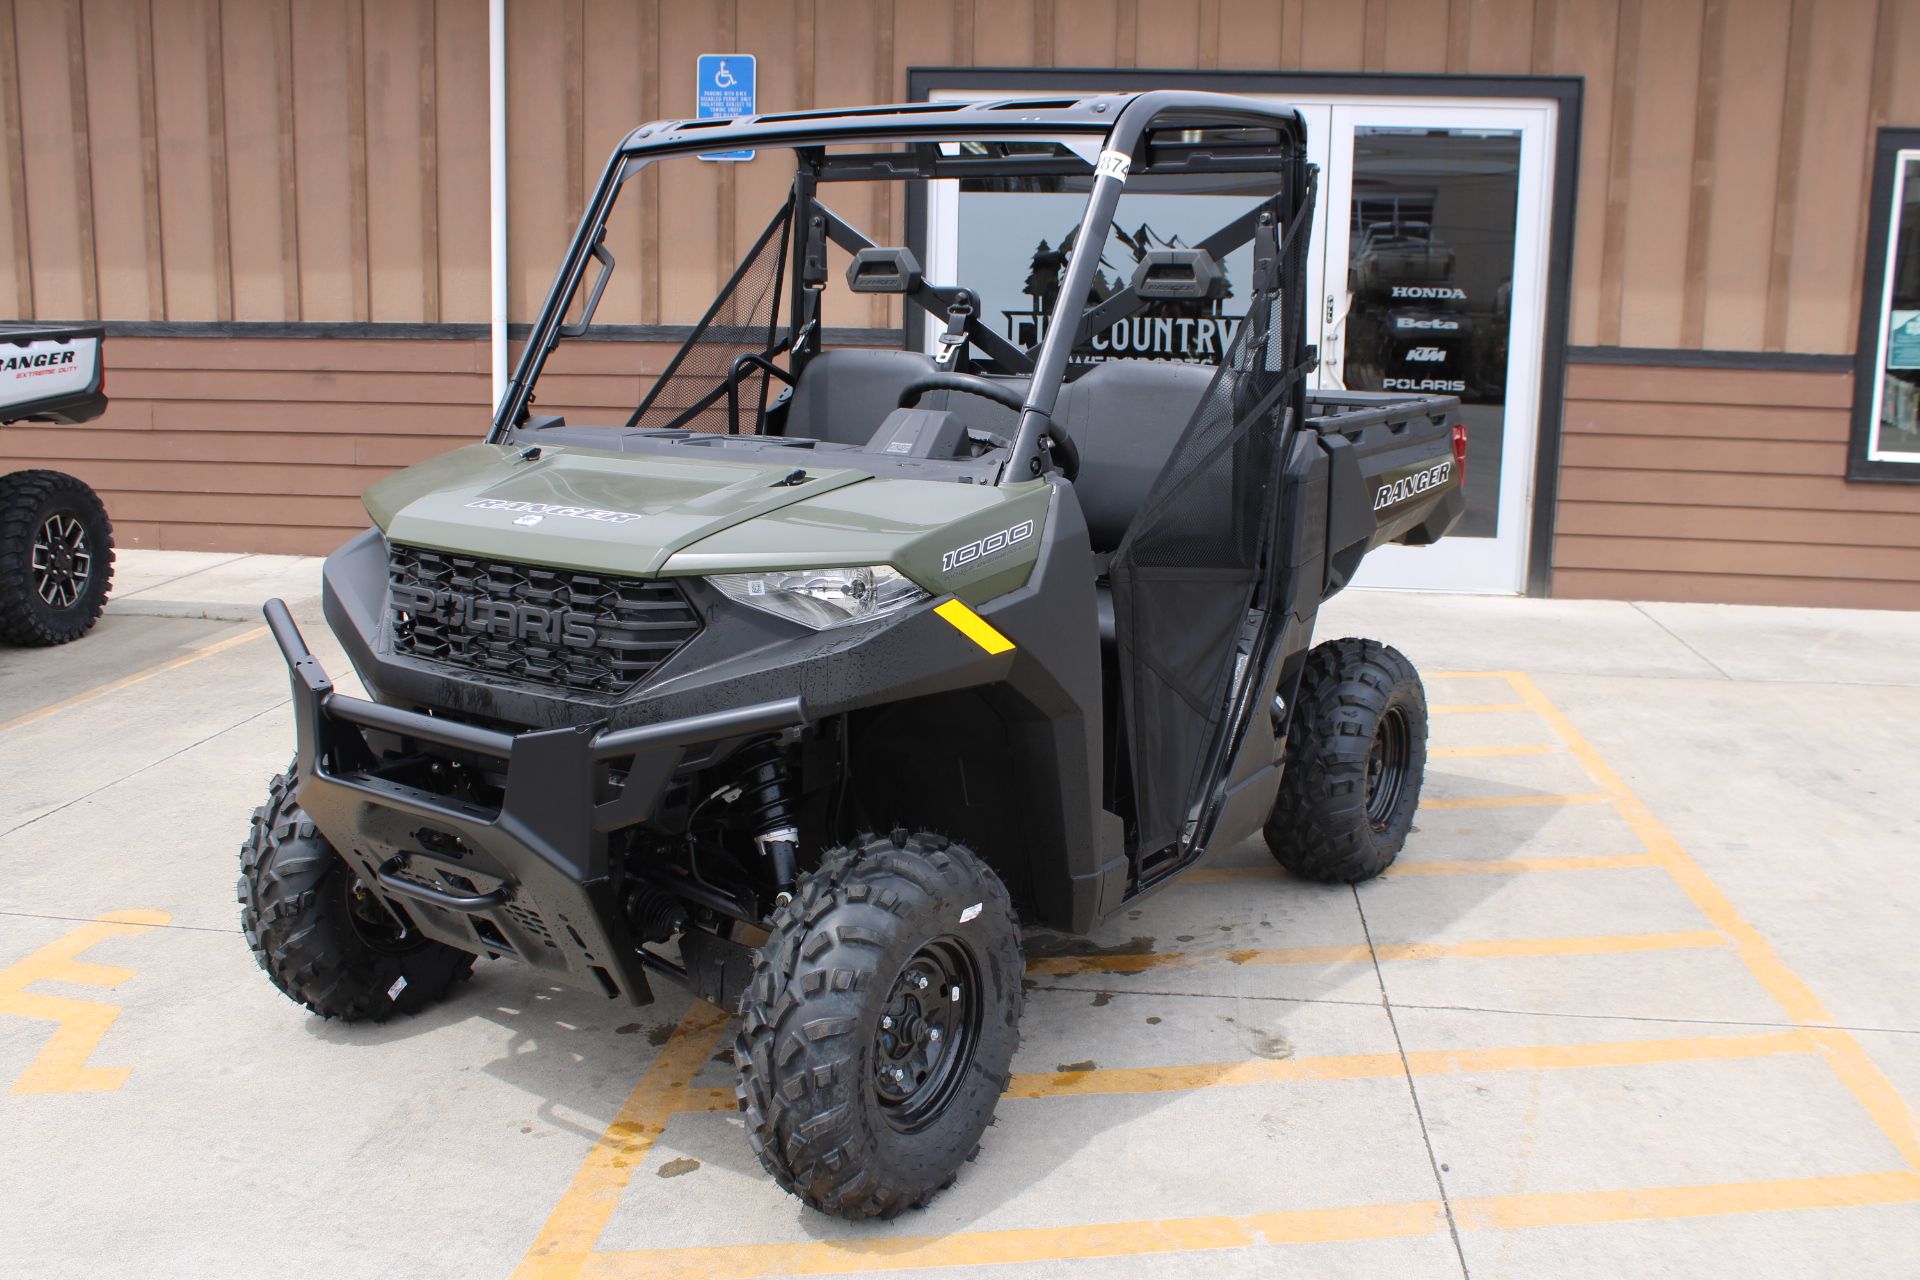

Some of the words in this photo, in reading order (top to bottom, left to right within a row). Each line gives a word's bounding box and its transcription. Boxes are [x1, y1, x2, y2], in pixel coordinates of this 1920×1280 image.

[1391, 286, 1467, 299] HONDA
[1397, 317, 1459, 330] Beta
[1405, 346, 1447, 362] KTM
[15, 369, 56, 379] EXTREME
[58, 366, 78, 374] DUTY
[1383, 378, 1466, 391] POLARIS
[1373, 461, 1451, 511] RANGER
[464, 499, 642, 524] RANGER
[942, 519, 1034, 573] 1000
[412, 586, 597, 648] POLARIS
